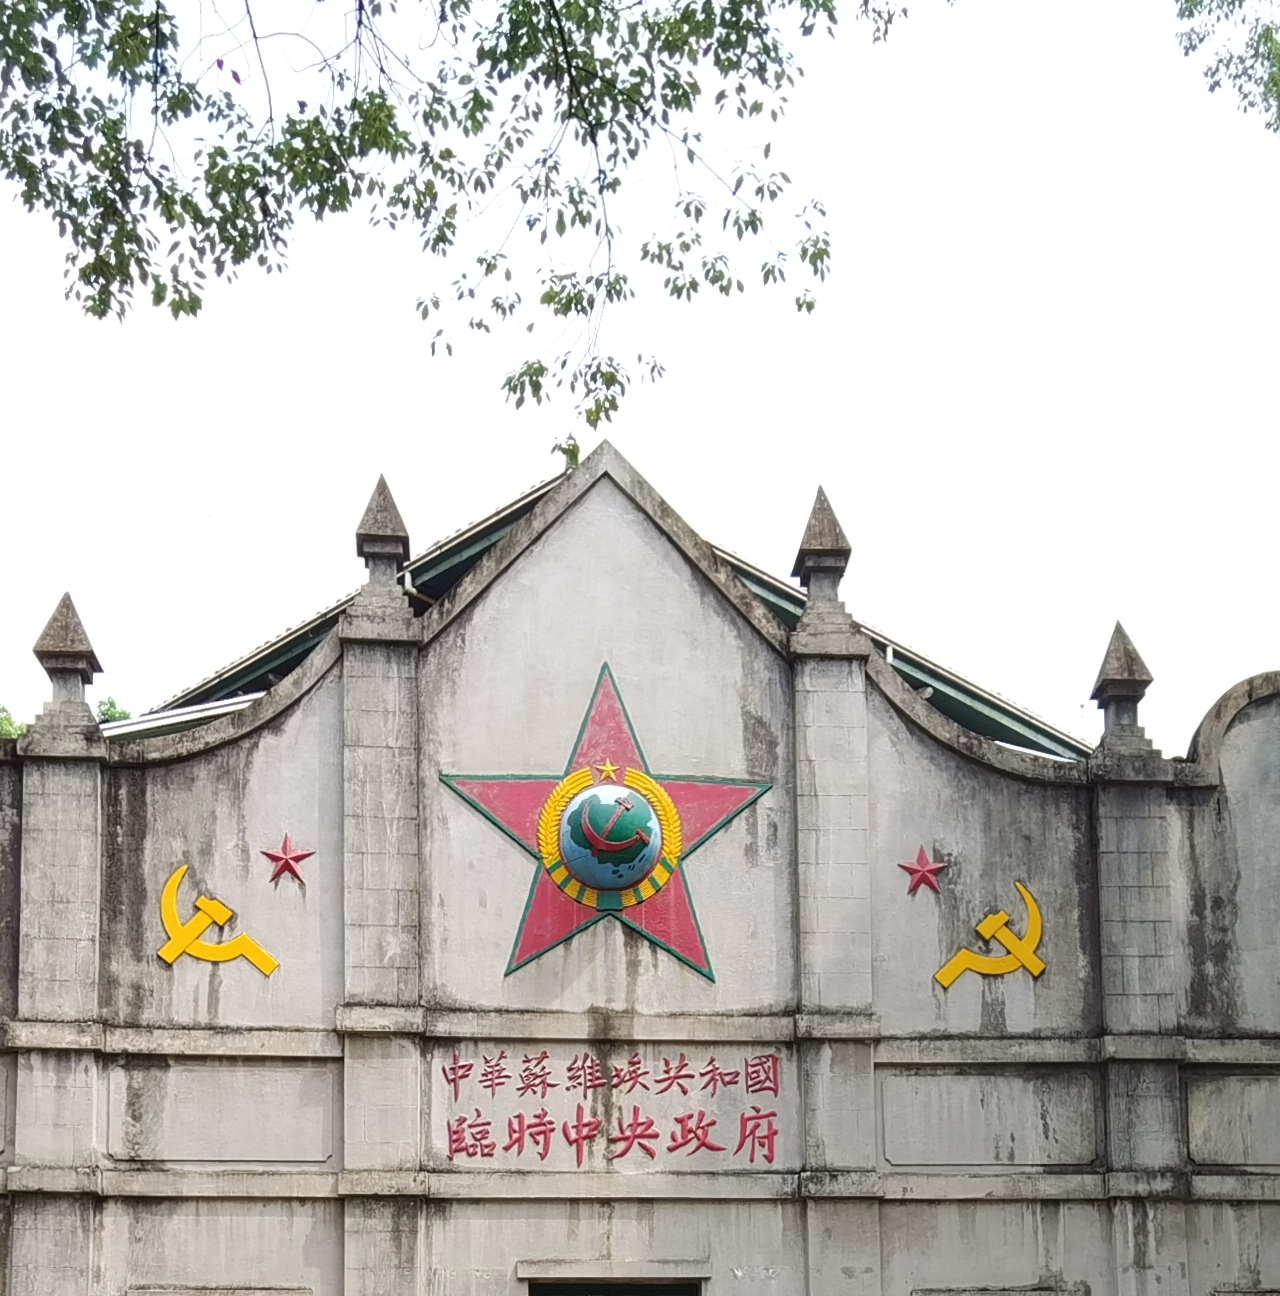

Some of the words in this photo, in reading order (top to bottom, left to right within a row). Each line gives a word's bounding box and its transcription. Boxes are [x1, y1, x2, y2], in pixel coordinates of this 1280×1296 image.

[441, 1049, 780, 1103] 中華蘇維埃共和國
[446, 1103, 780, 1168] 臨時中央政府
